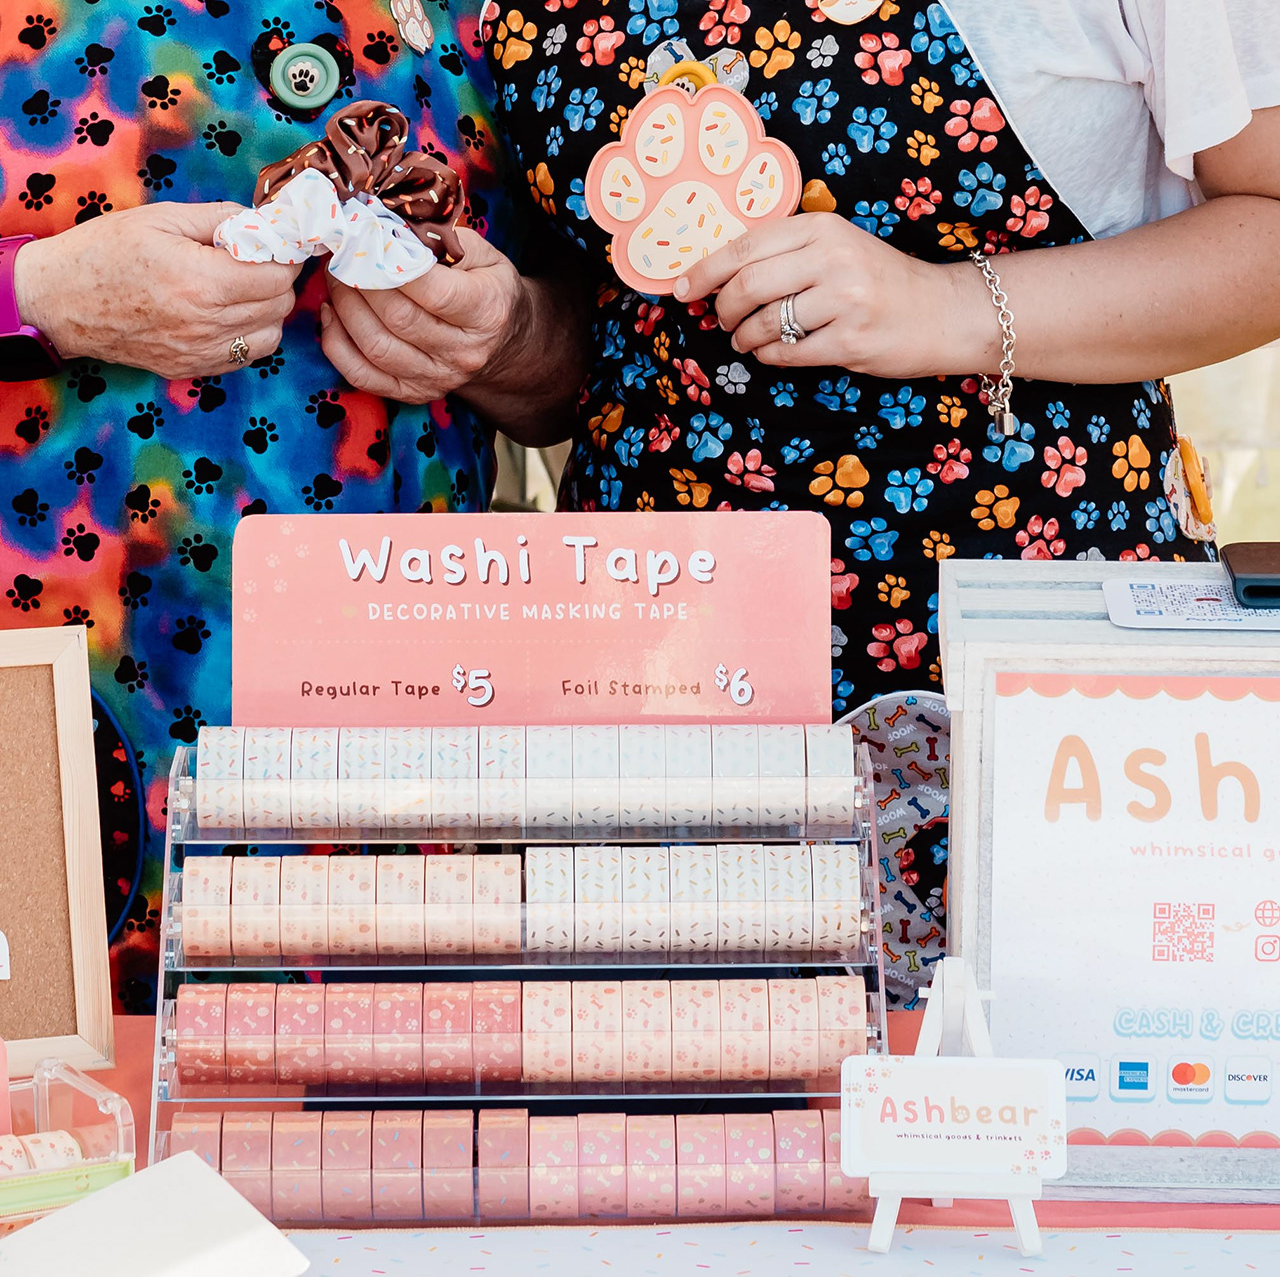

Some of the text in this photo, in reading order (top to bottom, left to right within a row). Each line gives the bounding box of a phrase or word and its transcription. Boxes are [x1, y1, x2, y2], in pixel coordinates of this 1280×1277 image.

[338, 534, 717, 597] Washi Tape
[368, 602, 688, 621] DECORATIVE MASKING TAPE
[300, 664, 495, 707] Regular Tape $5
[562, 662, 755, 706] Foil Stamped $6
[1129, 841, 1252, 859] whimsical
[1114, 1007, 1193, 1039] CASH
[1199, 1008, 1225, 1041] &
[1227, 1073, 1269, 1083] DISCOVER
[879, 1095, 1039, 1126] Ashbear
[896, 1132, 943, 1140] whimsical
[986, 1134, 1023, 1142] trinkets
